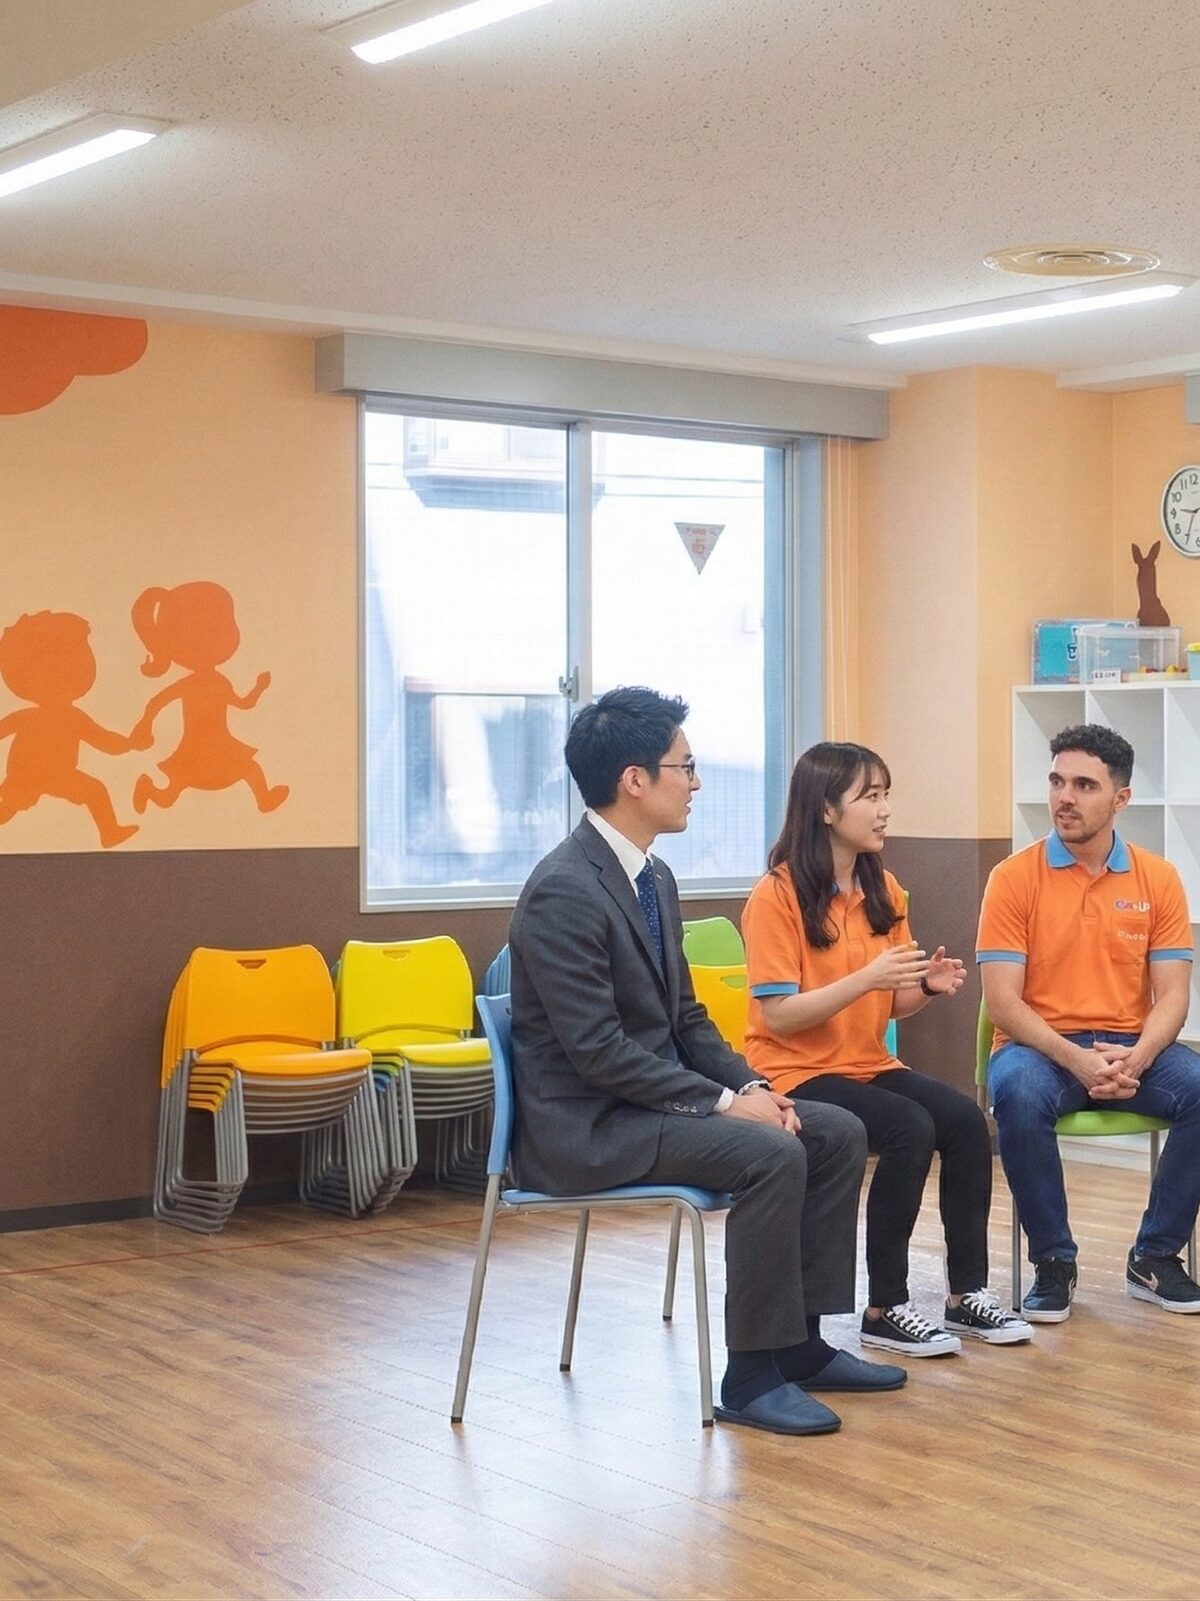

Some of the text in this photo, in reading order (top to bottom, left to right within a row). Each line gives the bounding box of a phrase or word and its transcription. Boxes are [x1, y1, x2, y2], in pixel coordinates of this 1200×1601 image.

[1180, 479, 1188, 490] 11
[1189, 473, 1199, 485] 12
[1171, 491, 1182, 503] 10
[1170, 507, 1177, 519] 9
[1175, 523, 1181, 535] 8
[1185, 534, 1190, 544] 7
[1196, 537, 1200, 547] 6
